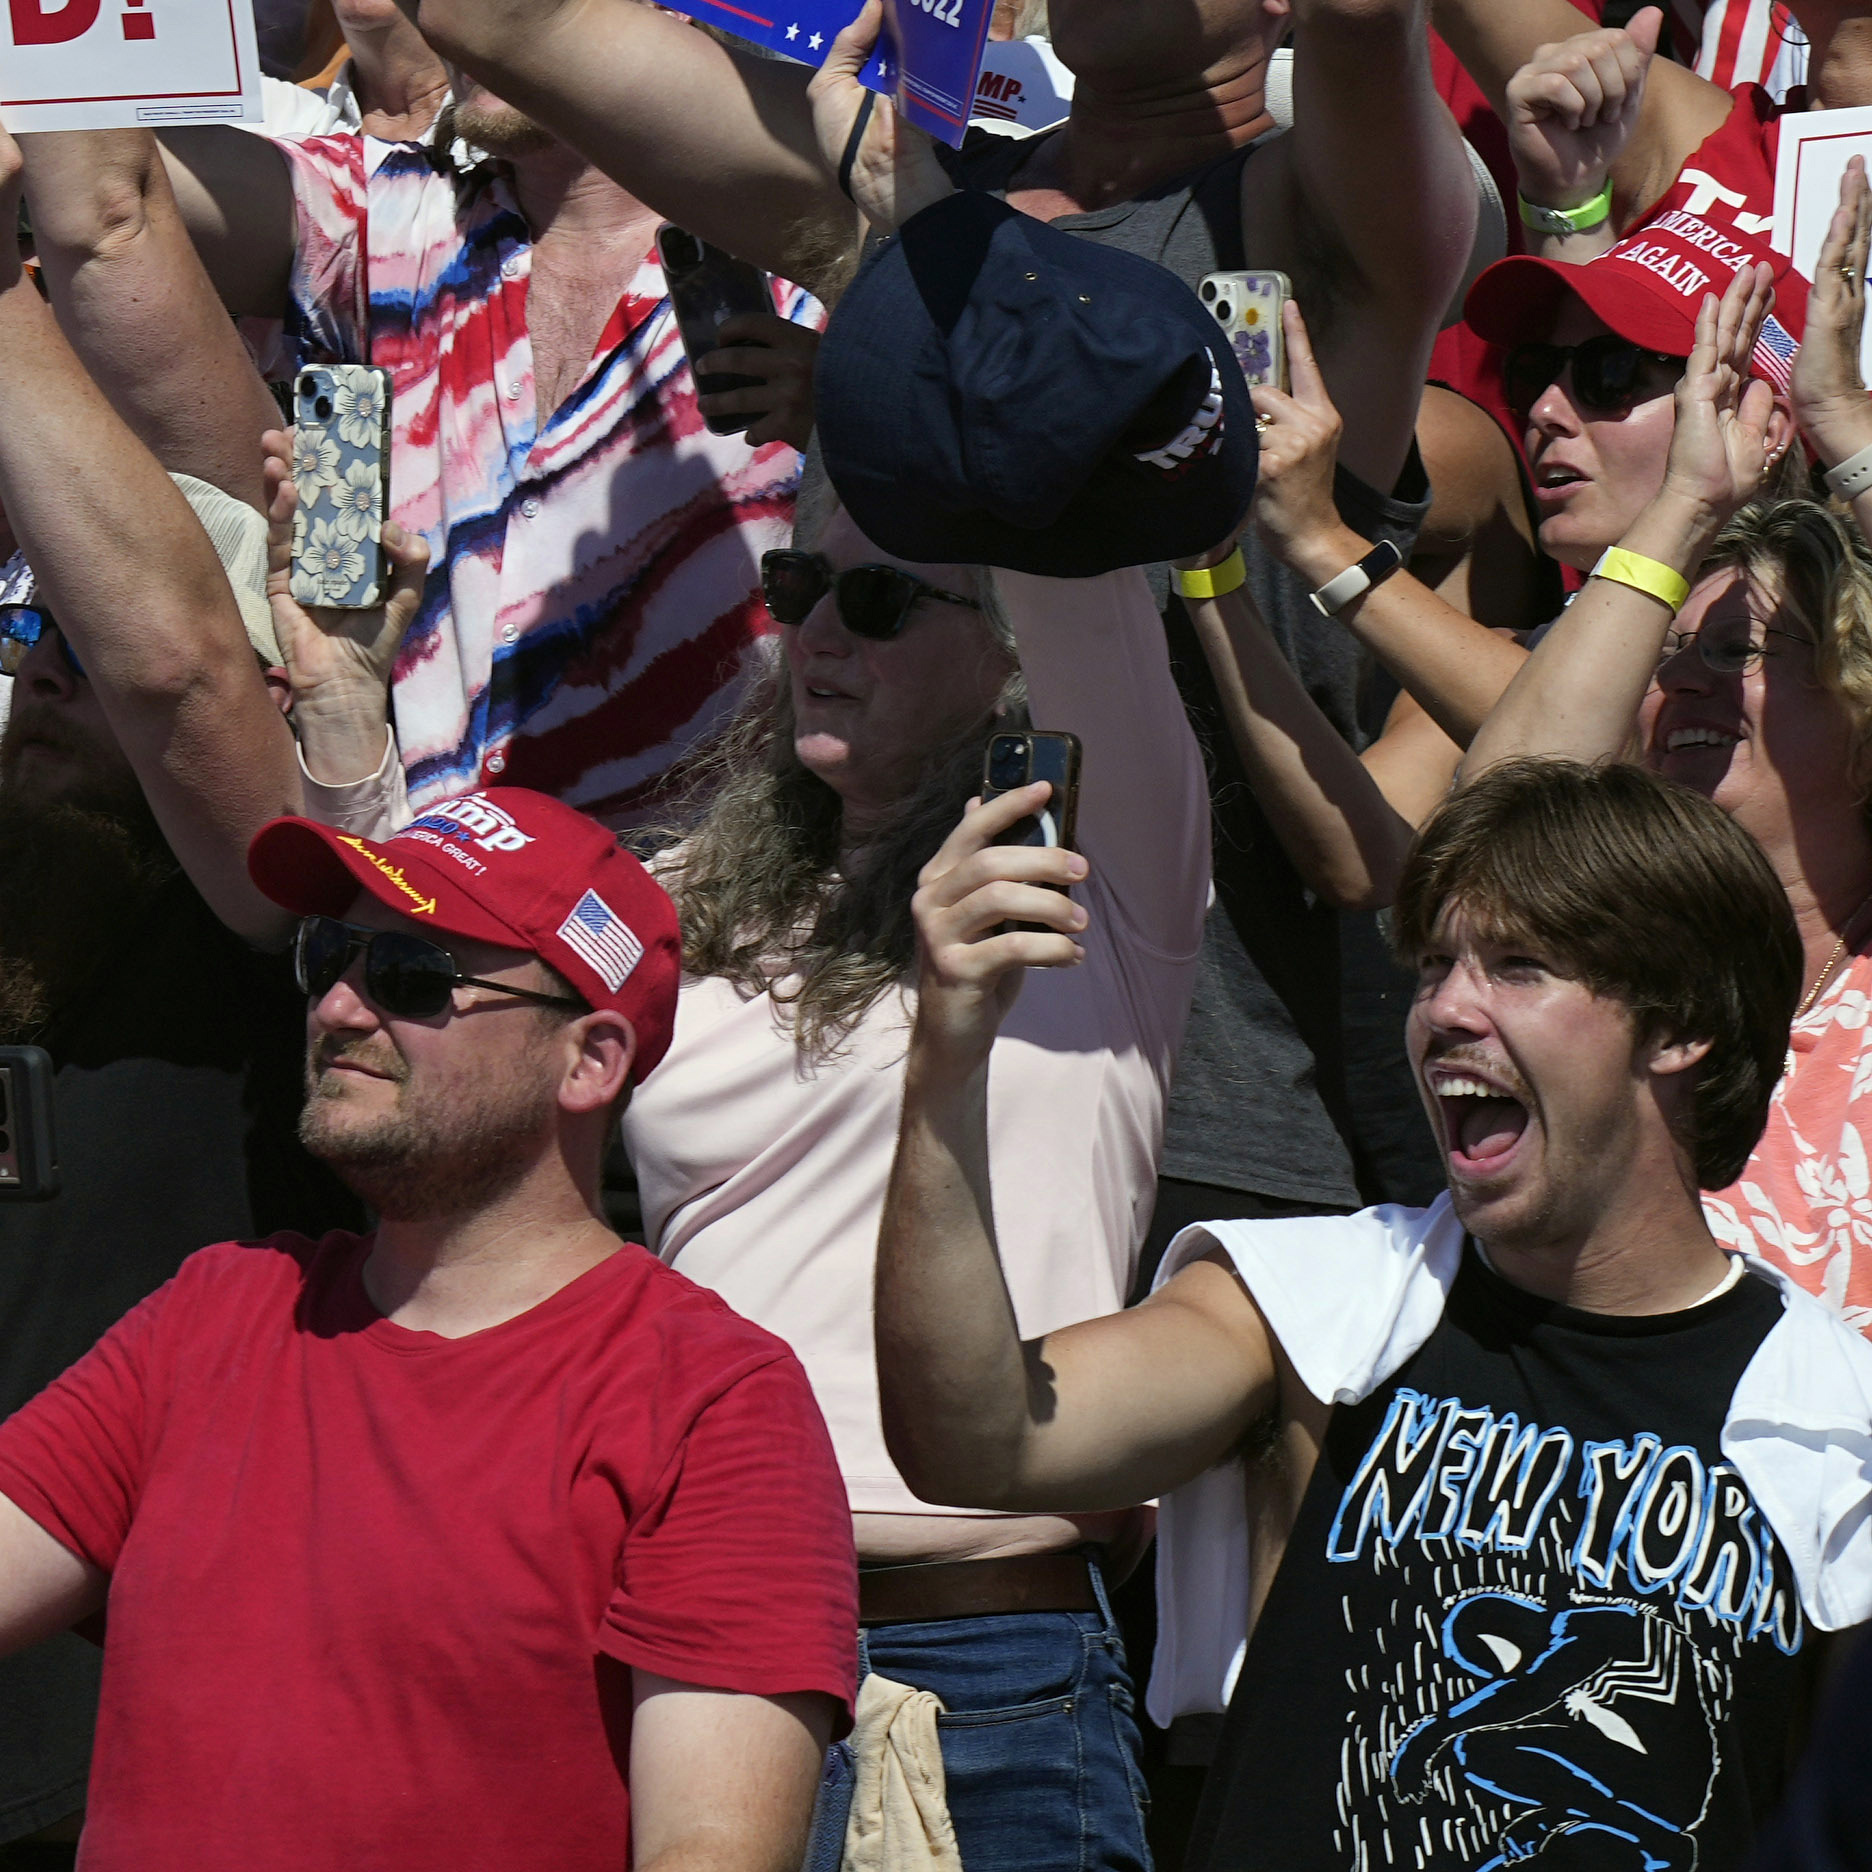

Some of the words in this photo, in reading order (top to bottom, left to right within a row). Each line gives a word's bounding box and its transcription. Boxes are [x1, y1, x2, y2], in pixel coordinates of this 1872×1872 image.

[1624, 239, 1712, 298] AGAIN
[1641, 210, 1754, 272] AMERICA
[1326, 1384, 1572, 1564] NEW
